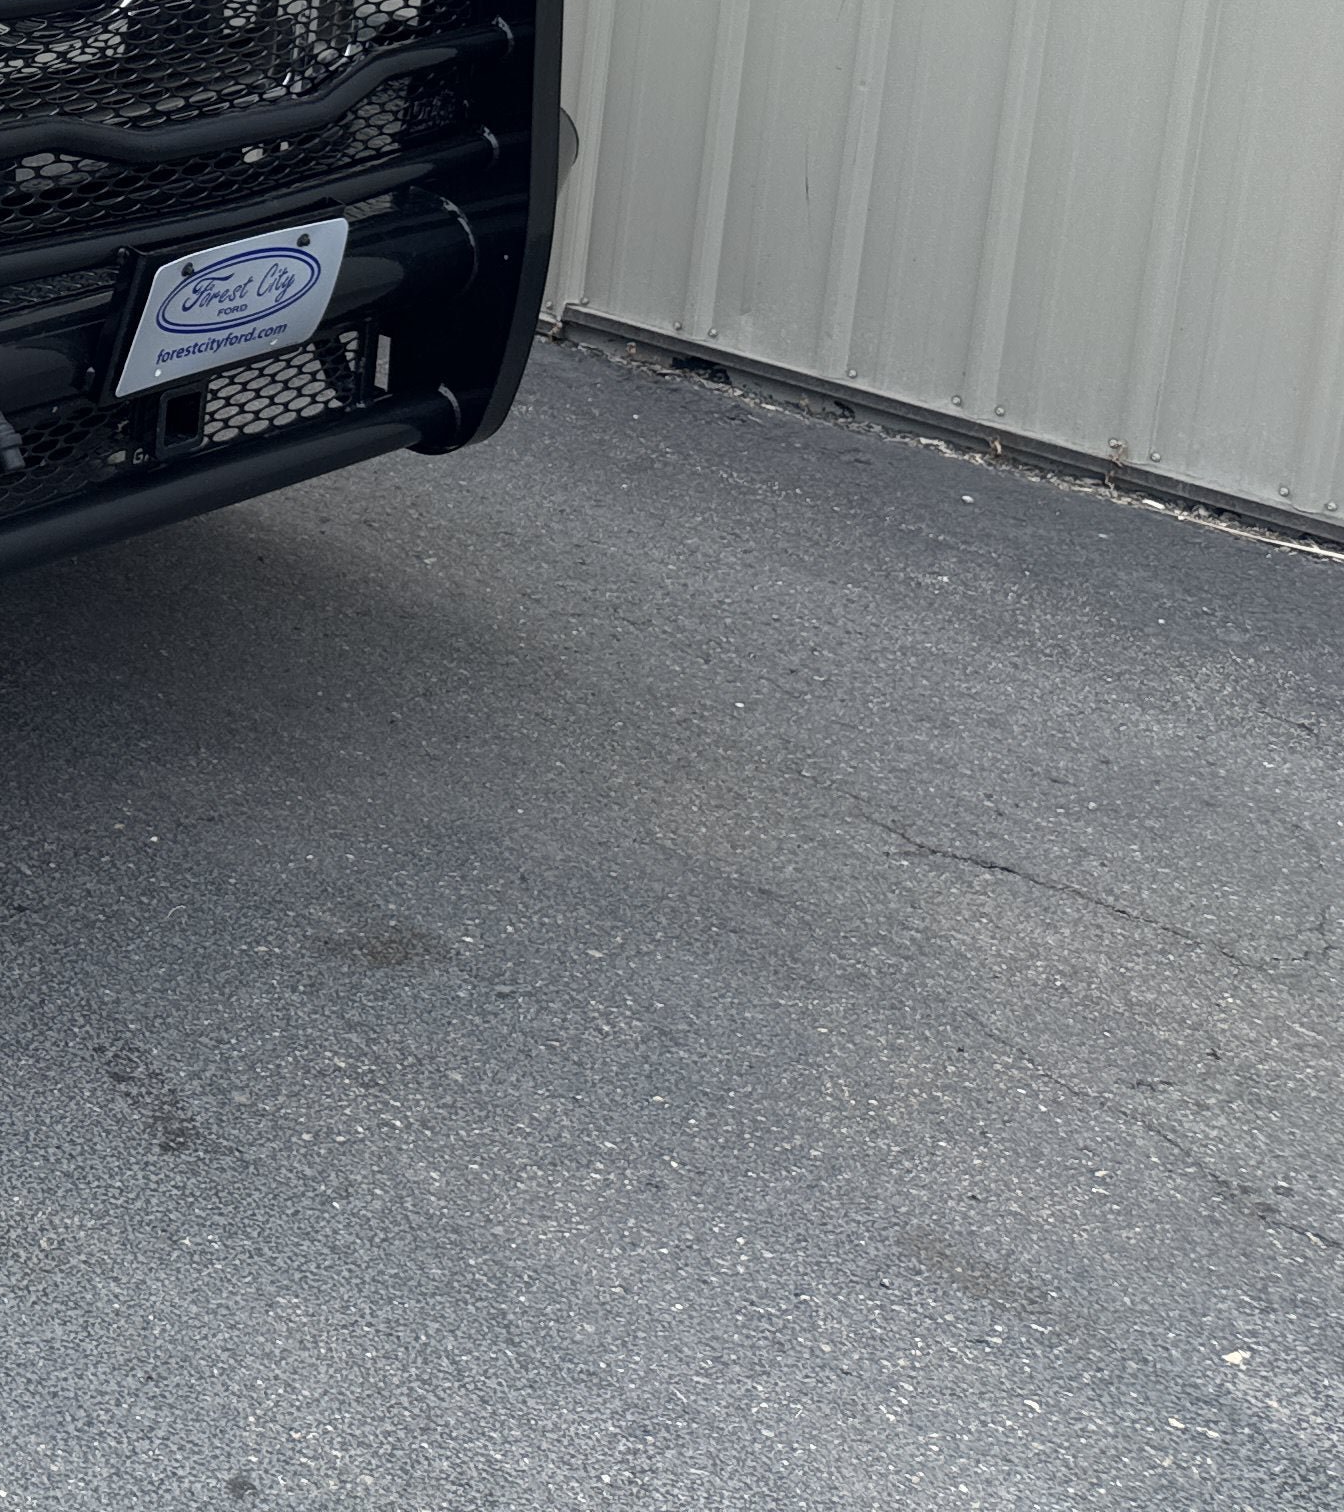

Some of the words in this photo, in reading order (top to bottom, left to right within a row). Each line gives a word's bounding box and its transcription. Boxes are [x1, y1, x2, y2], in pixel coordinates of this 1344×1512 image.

[181, 273, 253, 312] Forest
[256, 262, 295, 303] City
[216, 303, 248, 317] FORD
[156, 321, 287, 365] forestcityford.com
